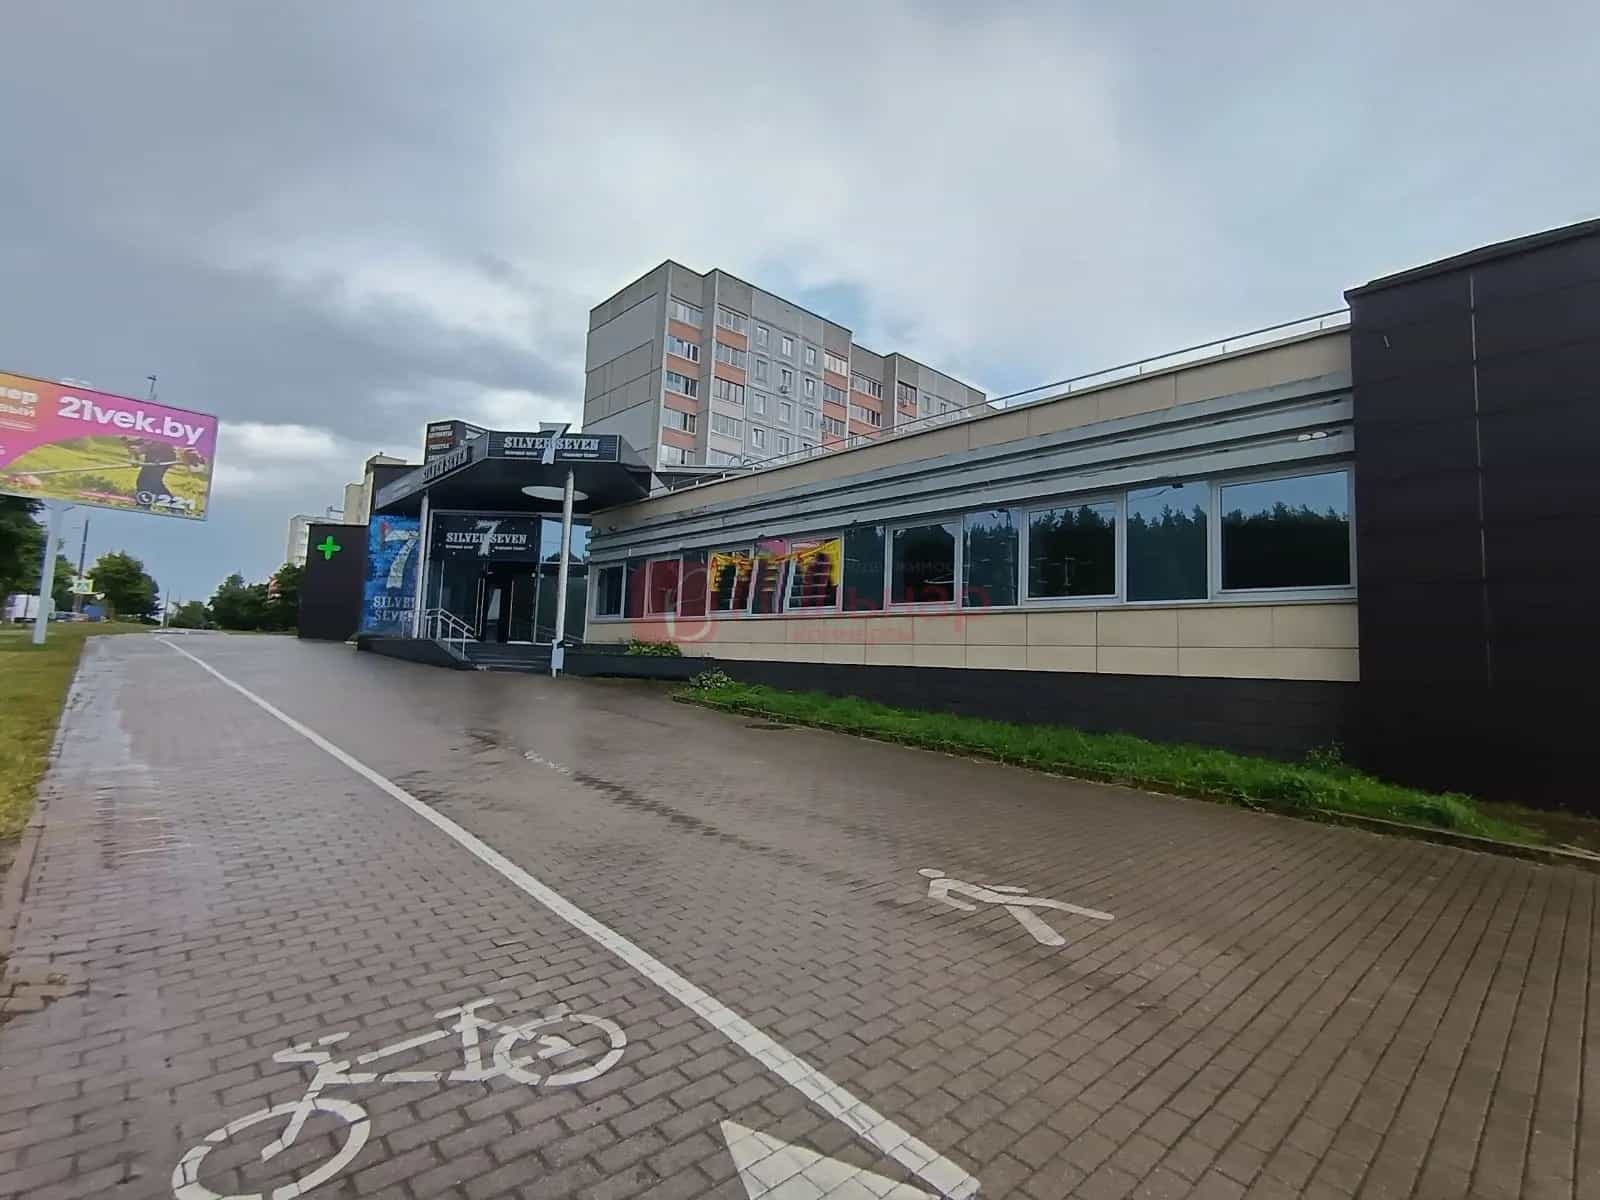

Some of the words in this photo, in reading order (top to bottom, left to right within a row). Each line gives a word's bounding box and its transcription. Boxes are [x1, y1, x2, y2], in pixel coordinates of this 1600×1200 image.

[57, 395, 205, 446] 21vek.by
[555, 438, 601, 451] SEVEN
[489, 533, 528, 544] SEVEN
